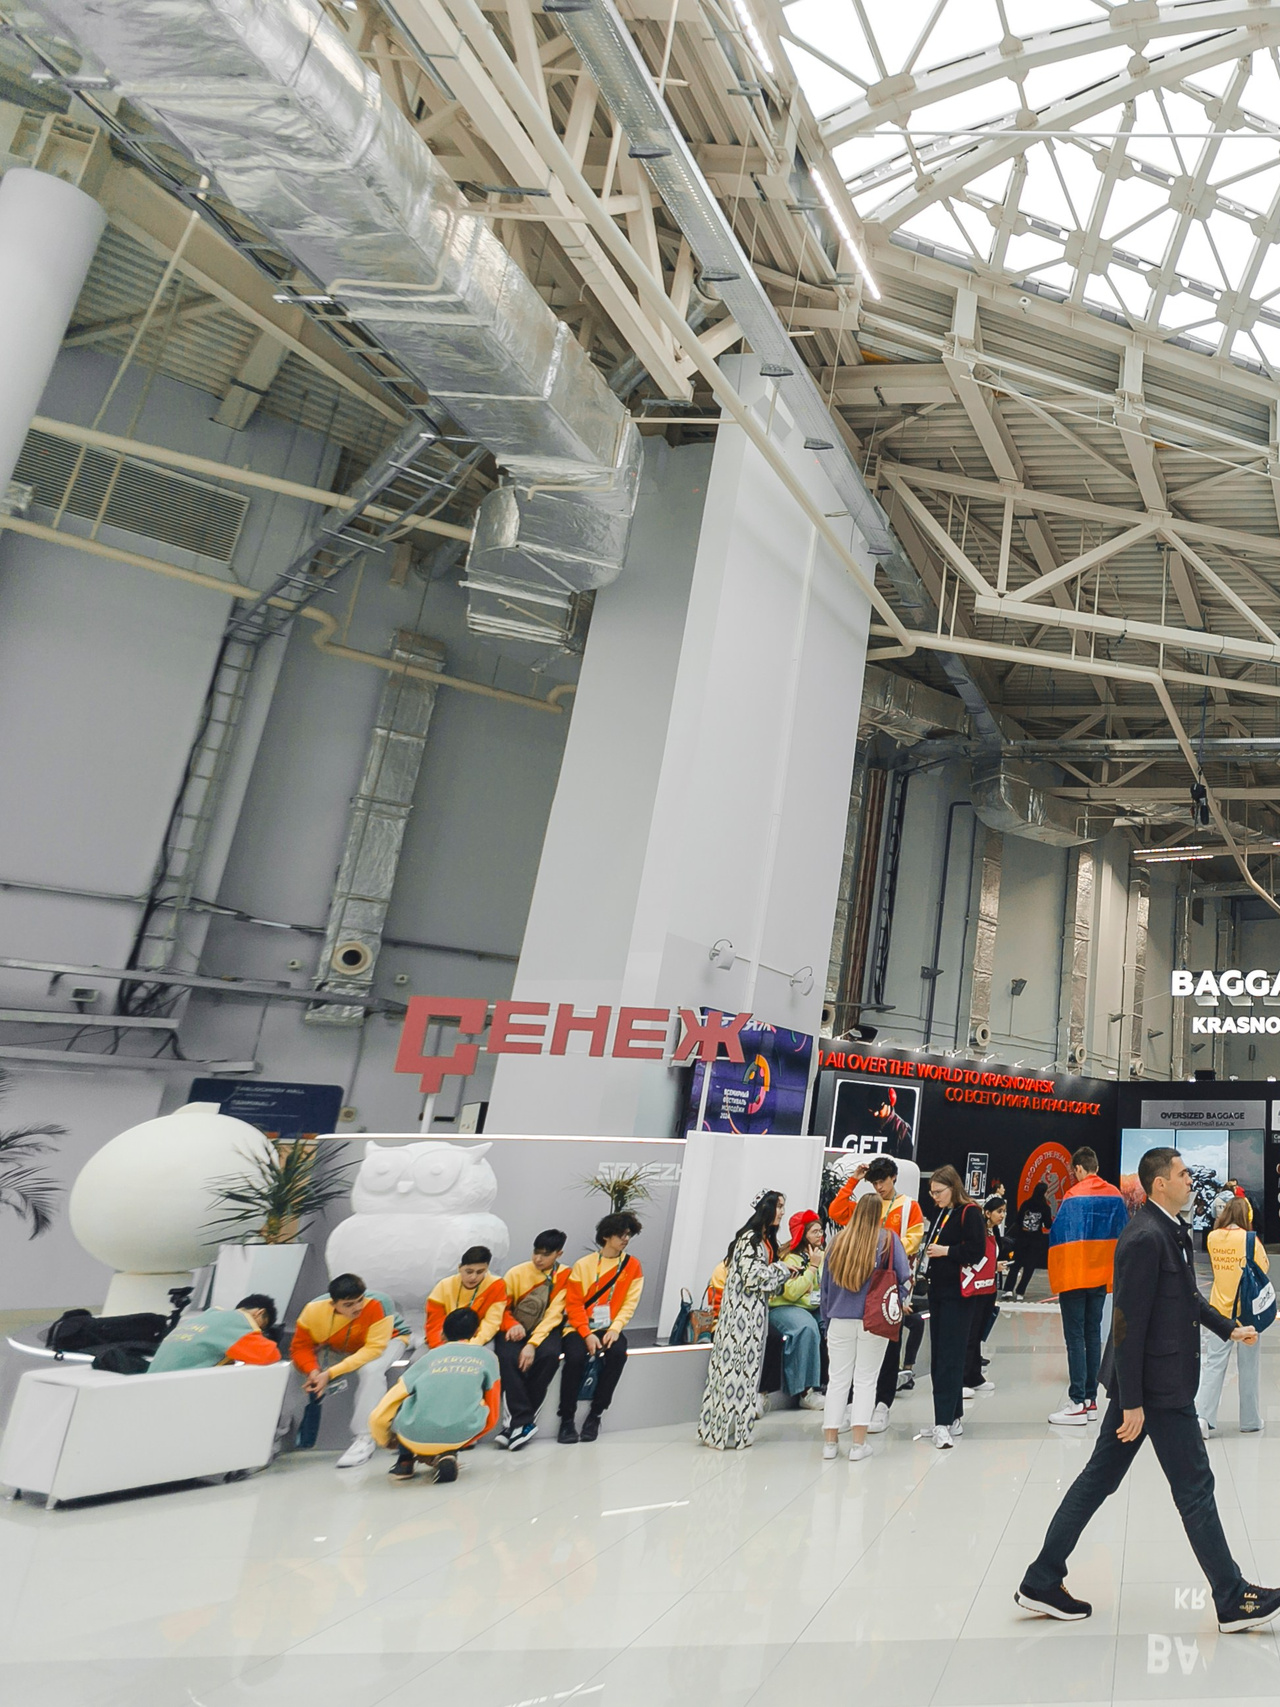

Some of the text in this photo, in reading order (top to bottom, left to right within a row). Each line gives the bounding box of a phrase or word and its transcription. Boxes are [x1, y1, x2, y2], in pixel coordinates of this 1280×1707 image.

[847, 1053, 887, 1074] OVER
[888, 1058, 915, 1077] THE
[917, 1062, 963, 1083] WORLD
[963, 1069, 981, 1085] TO
[980, 1071, 1056, 1094] KRASNOYARSK
[945, 1086, 1101, 1116] СО ВСЕГО МИРА В КРАСНОЯРСК
[1160, 1111, 1245, 1120] OVERSIZED BAGGAGE
[1212, 1247, 1236, 1255] СМЫСЛ
